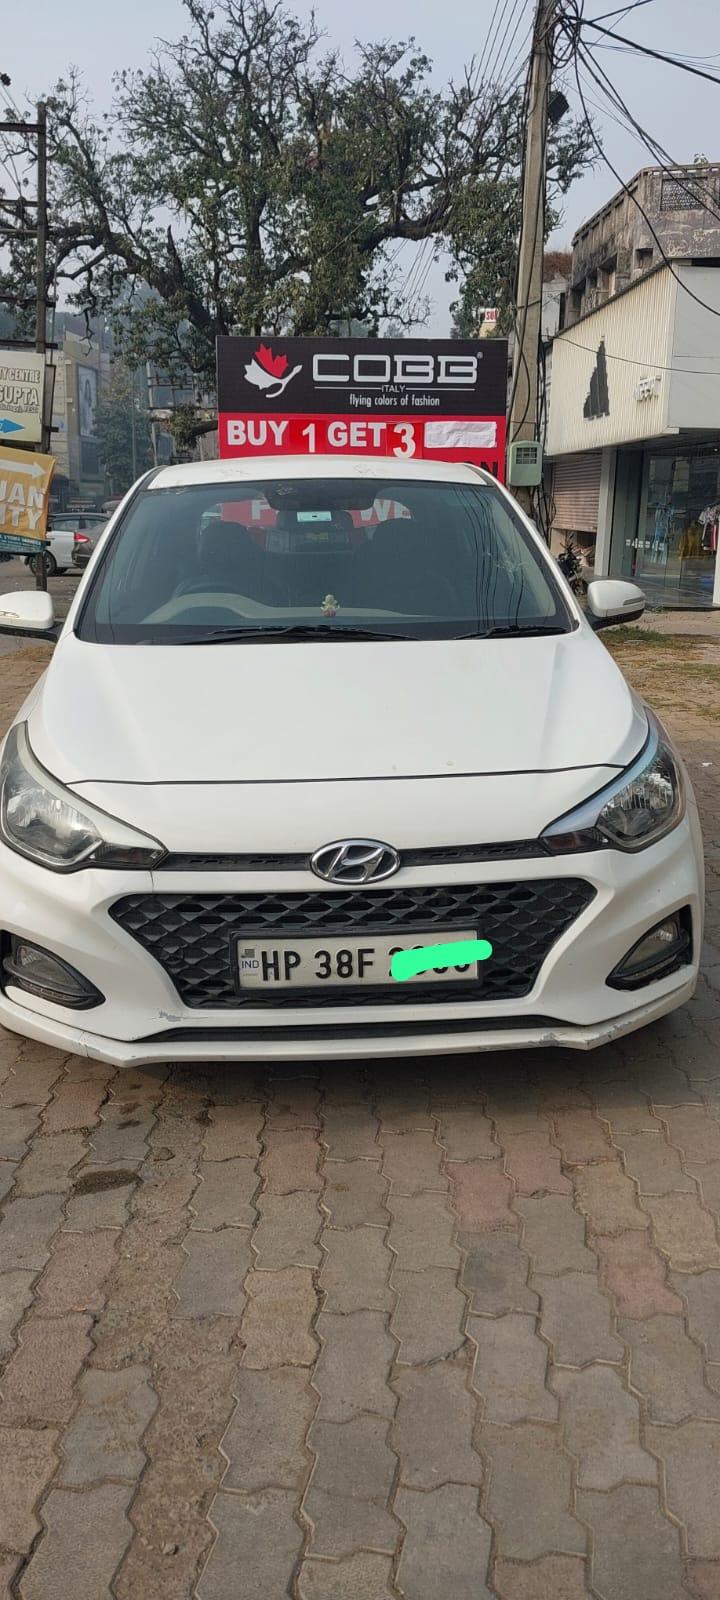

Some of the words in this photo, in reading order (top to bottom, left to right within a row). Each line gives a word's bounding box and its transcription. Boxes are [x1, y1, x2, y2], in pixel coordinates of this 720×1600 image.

[8, 368, 40, 383] CENTRE
[381, 385, 406, 393] ITALY
[350, 394, 371, 407] flying
[374, 394, 397, 406] colors
[400, 394, 408, 406] of
[411, 394, 440, 407] fashion
[226, 420, 289, 446] BUY
[302, 423, 315, 453] 1
[327, 421, 387, 447] GET
[393, 423, 416, 459] 3
[241, 960, 259, 969] IND
[261, 950, 301, 981] HP
[314, 948, 375, 979] 38F
